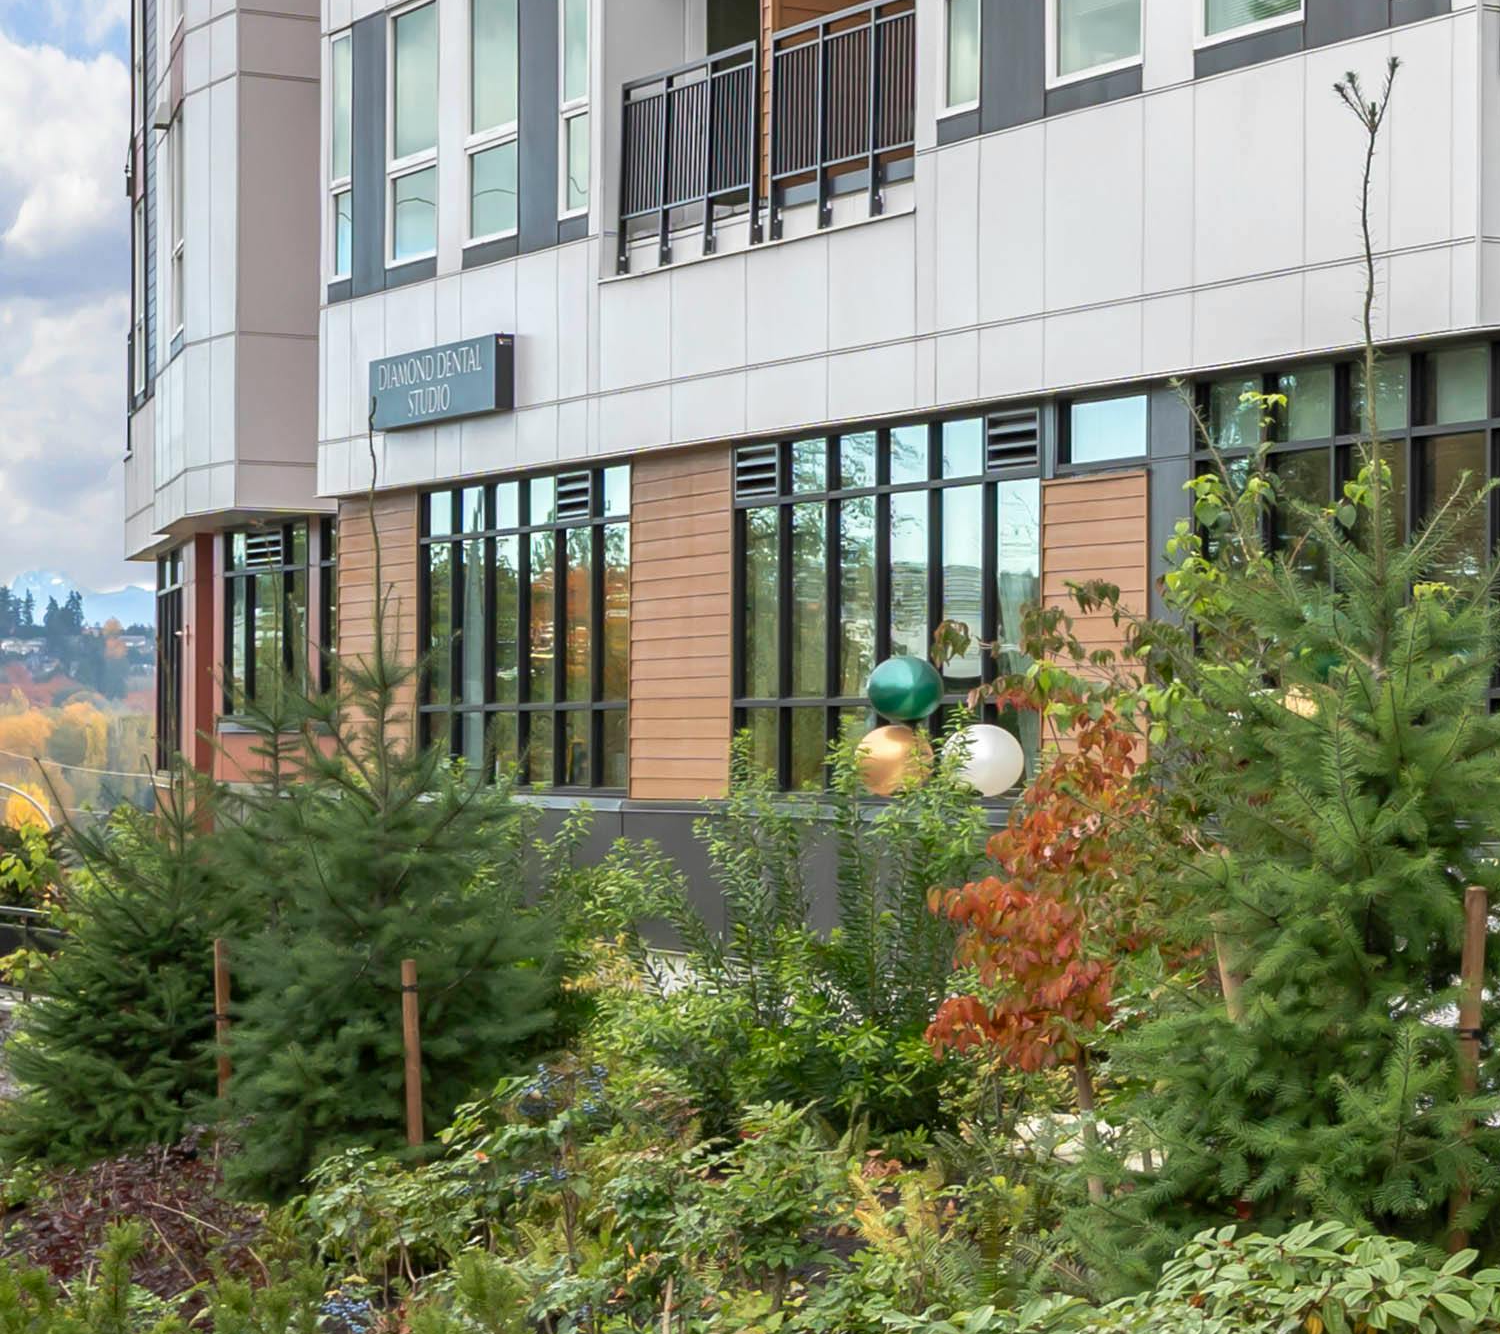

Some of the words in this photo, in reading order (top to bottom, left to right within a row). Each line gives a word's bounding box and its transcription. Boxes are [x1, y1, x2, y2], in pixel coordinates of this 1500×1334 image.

[378, 354, 435, 391] DIAMOND
[437, 344, 482, 379] DENTAL
[407, 384, 451, 417] STUDIO
